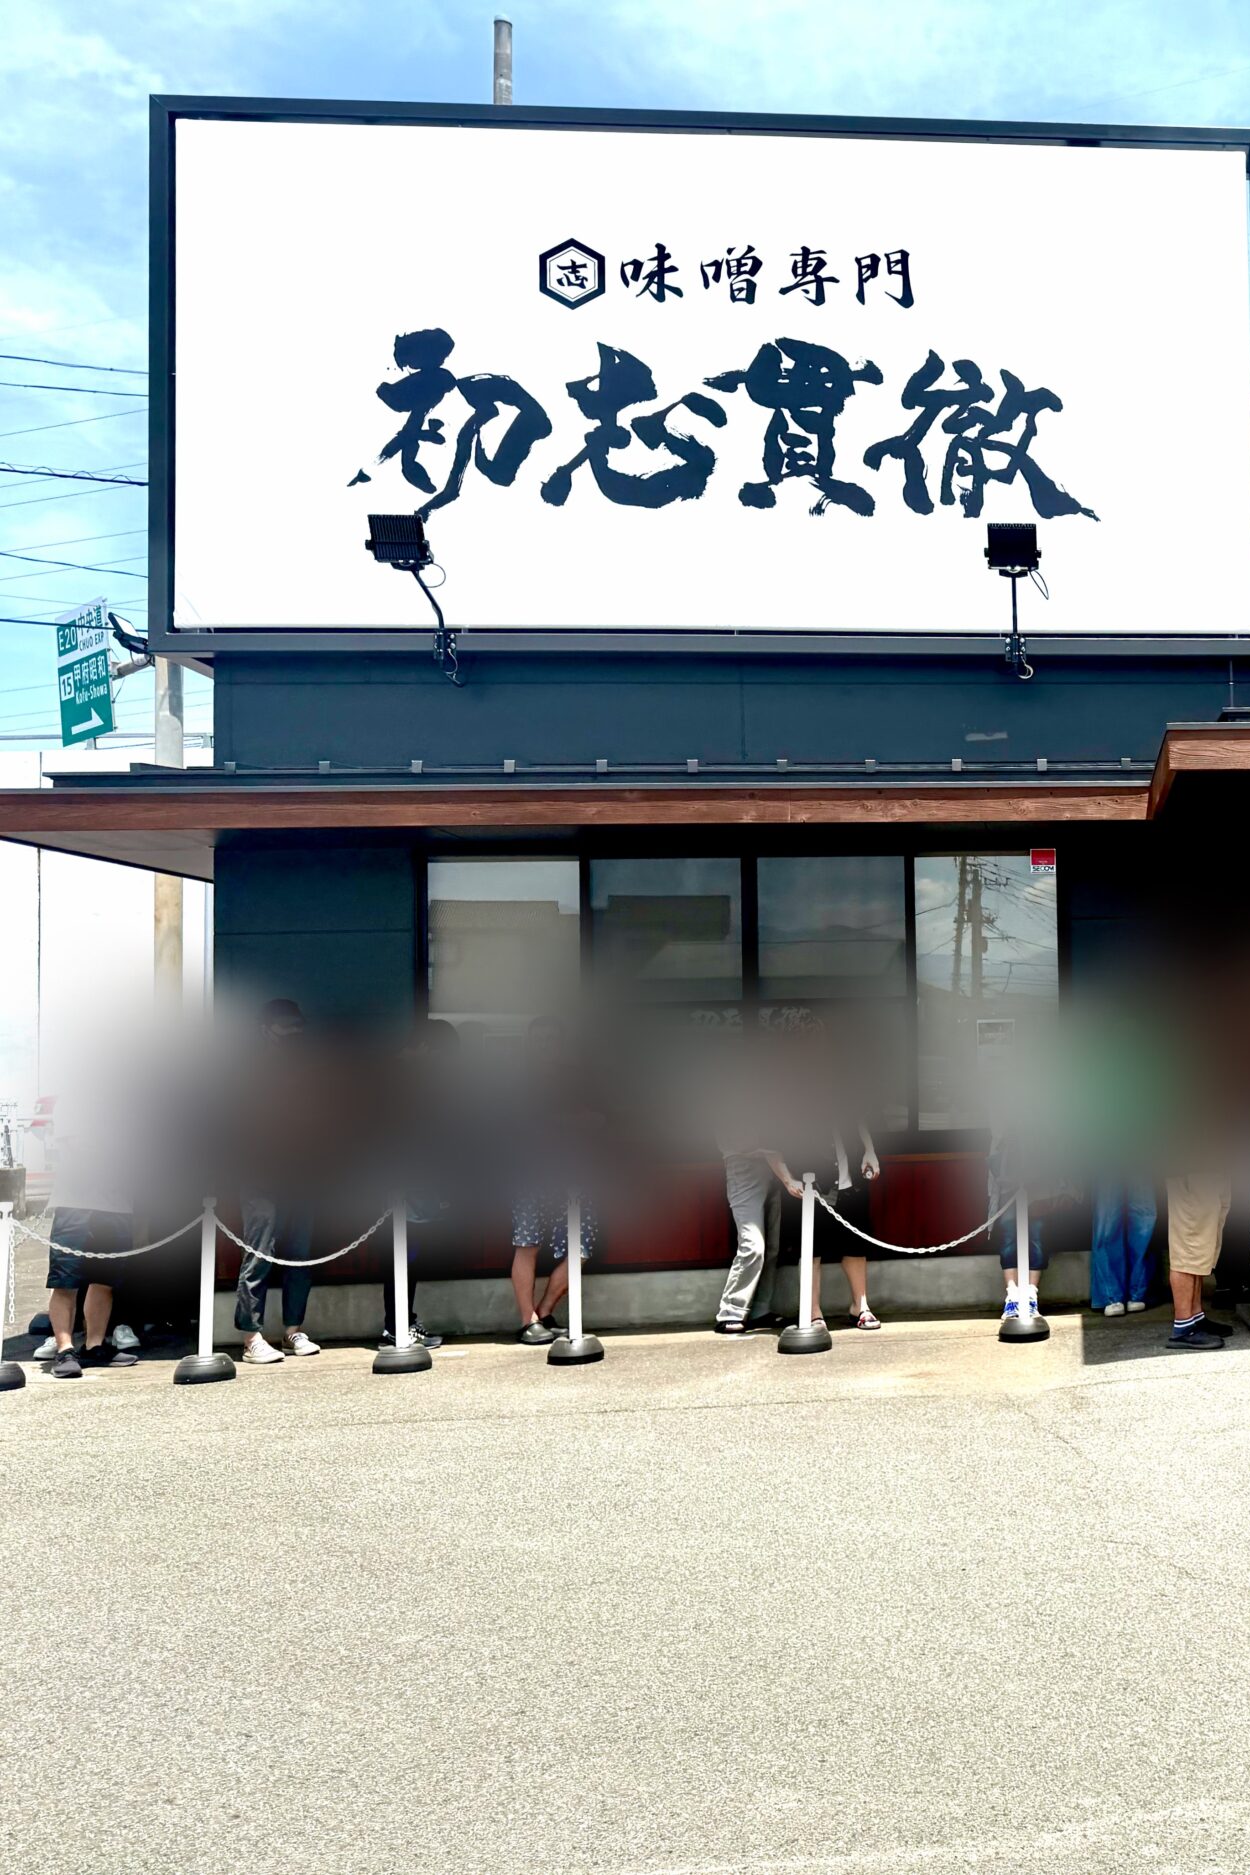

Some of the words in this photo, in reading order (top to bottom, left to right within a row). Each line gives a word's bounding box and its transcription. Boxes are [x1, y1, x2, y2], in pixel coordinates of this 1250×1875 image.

[347, 327, 1101, 522] 初志貫徹
[78, 605, 103, 636] 中央道
[59, 627, 77, 652] E20
[73, 655, 106, 688] 甲府昭和
[62, 676, 73, 697] 15
[75, 683, 108, 705] Kofu-Showa
